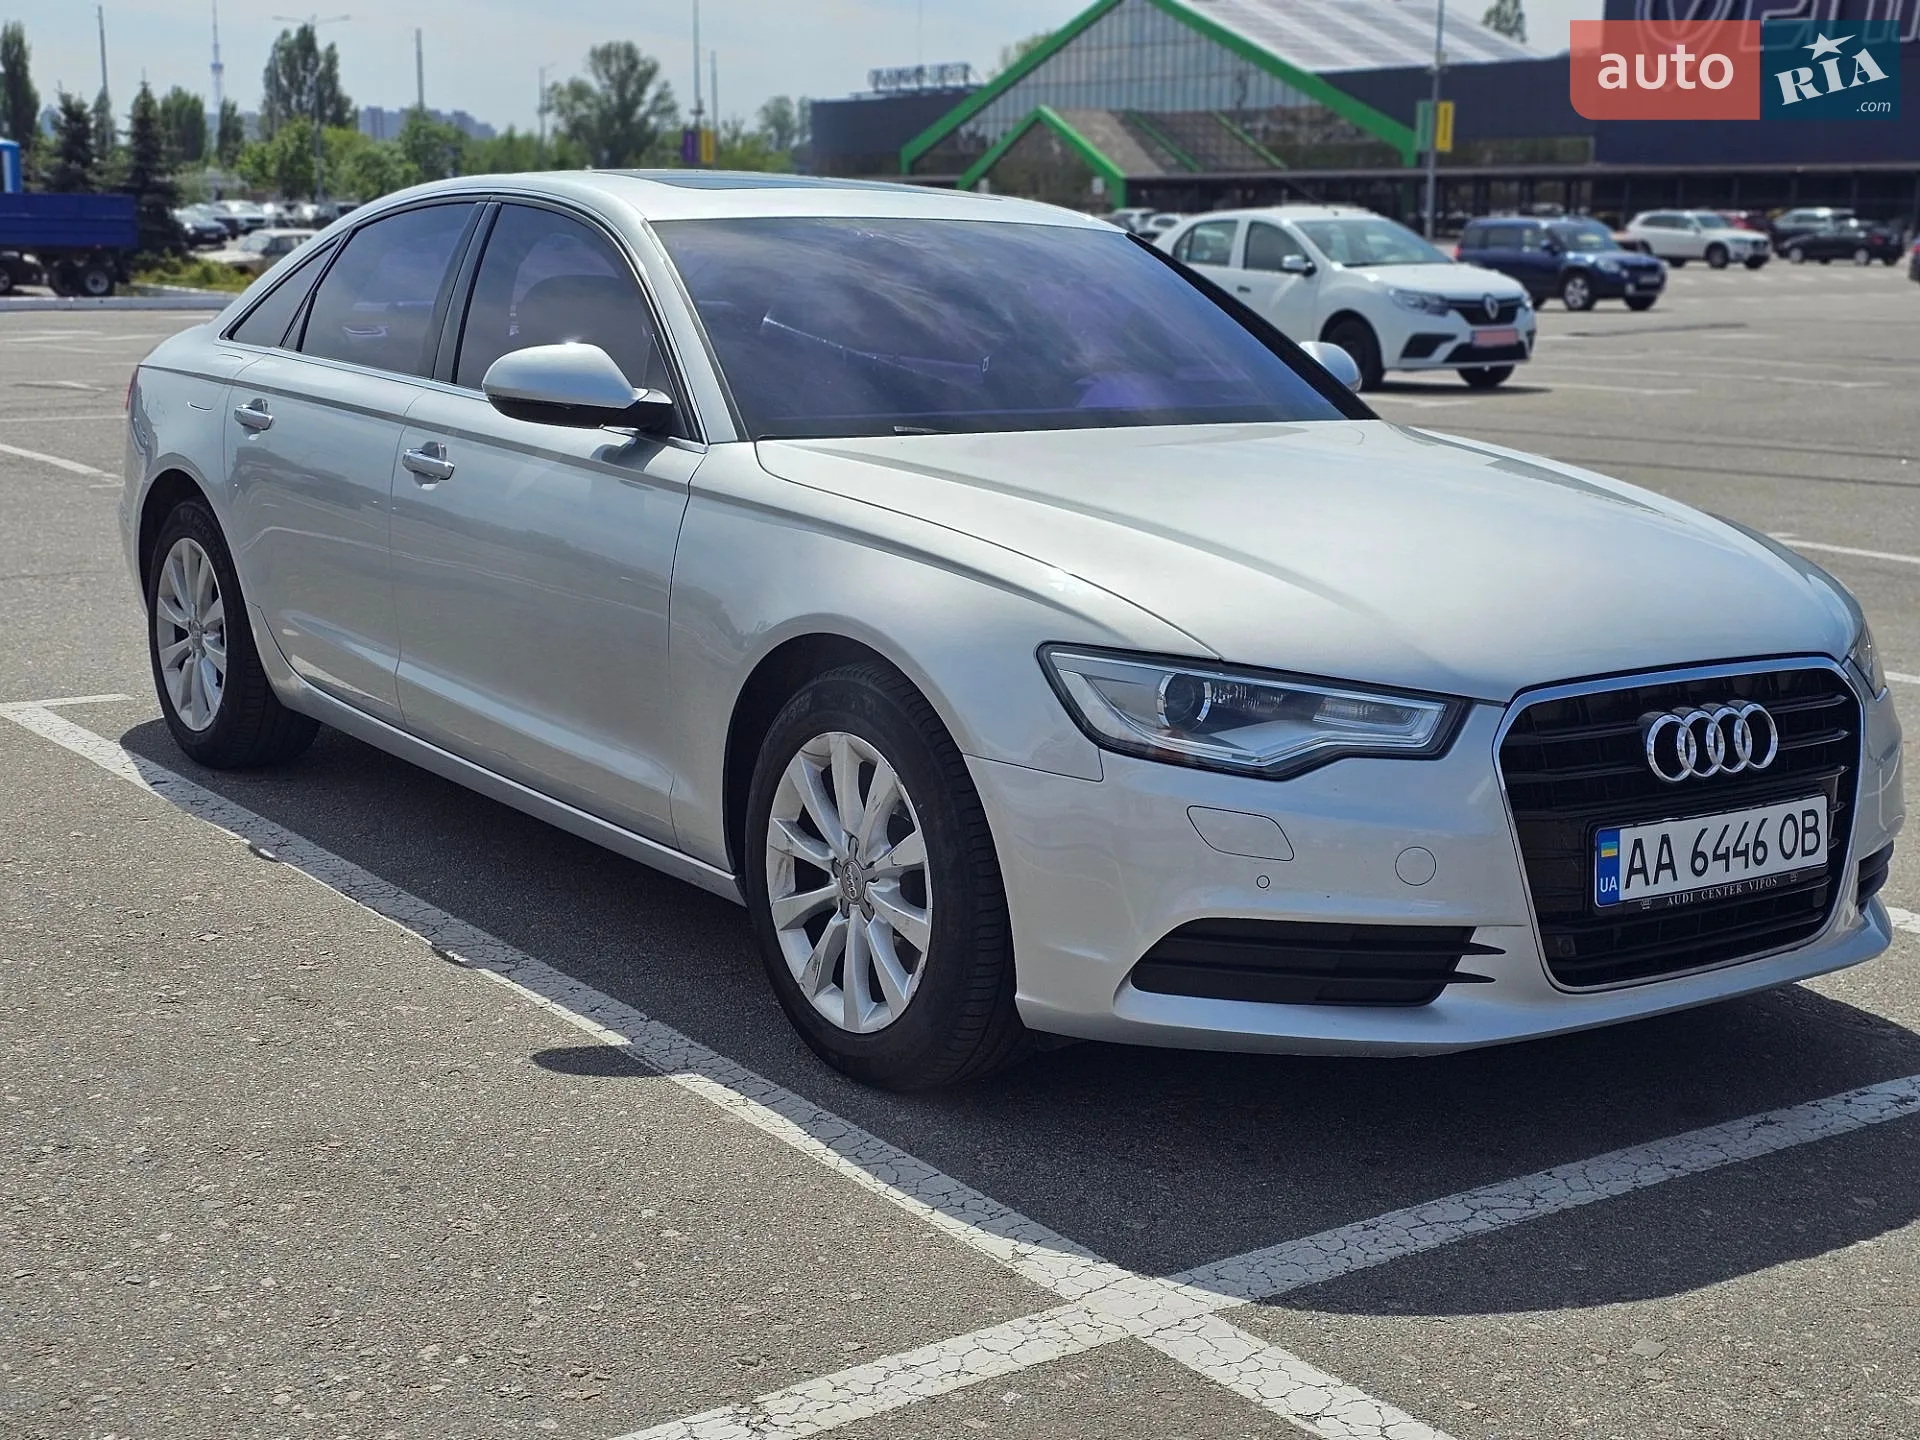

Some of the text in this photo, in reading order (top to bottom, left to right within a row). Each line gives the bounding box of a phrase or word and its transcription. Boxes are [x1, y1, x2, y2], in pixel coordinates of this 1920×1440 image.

[1624, 808, 1821, 890] AA 6446 OB
[1600, 876, 1618, 893] UA
[1666, 877, 1778, 907] AUDI CENTER VIPOS
